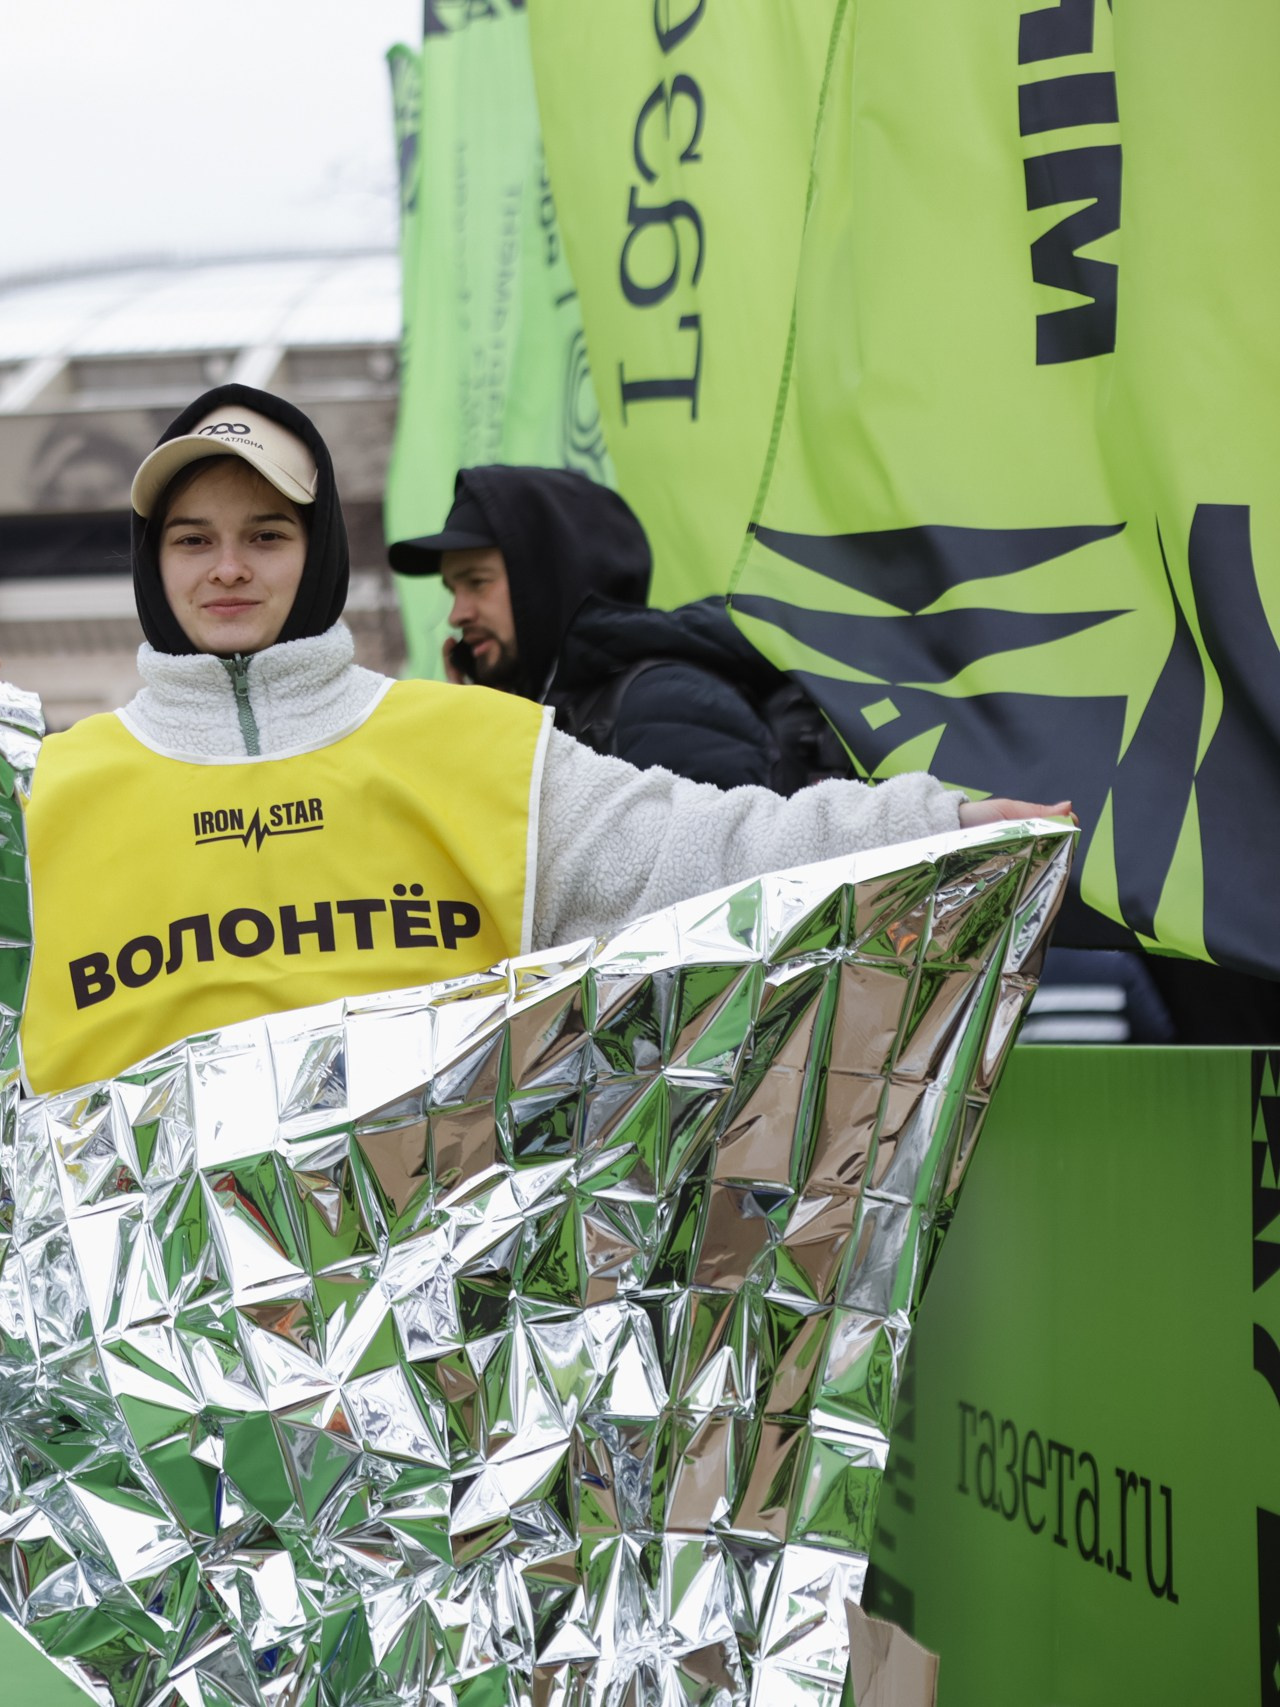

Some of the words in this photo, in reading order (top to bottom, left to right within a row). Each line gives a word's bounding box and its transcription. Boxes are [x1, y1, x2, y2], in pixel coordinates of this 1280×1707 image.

[220, 436, 265, 451] АТЛОНА
[193, 808, 245, 836] IRON
[269, 797, 324, 827] STAR
[68, 883, 481, 1011] ВОЛОНТЁР
[956, 1400, 1180, 1605] газета.ru
